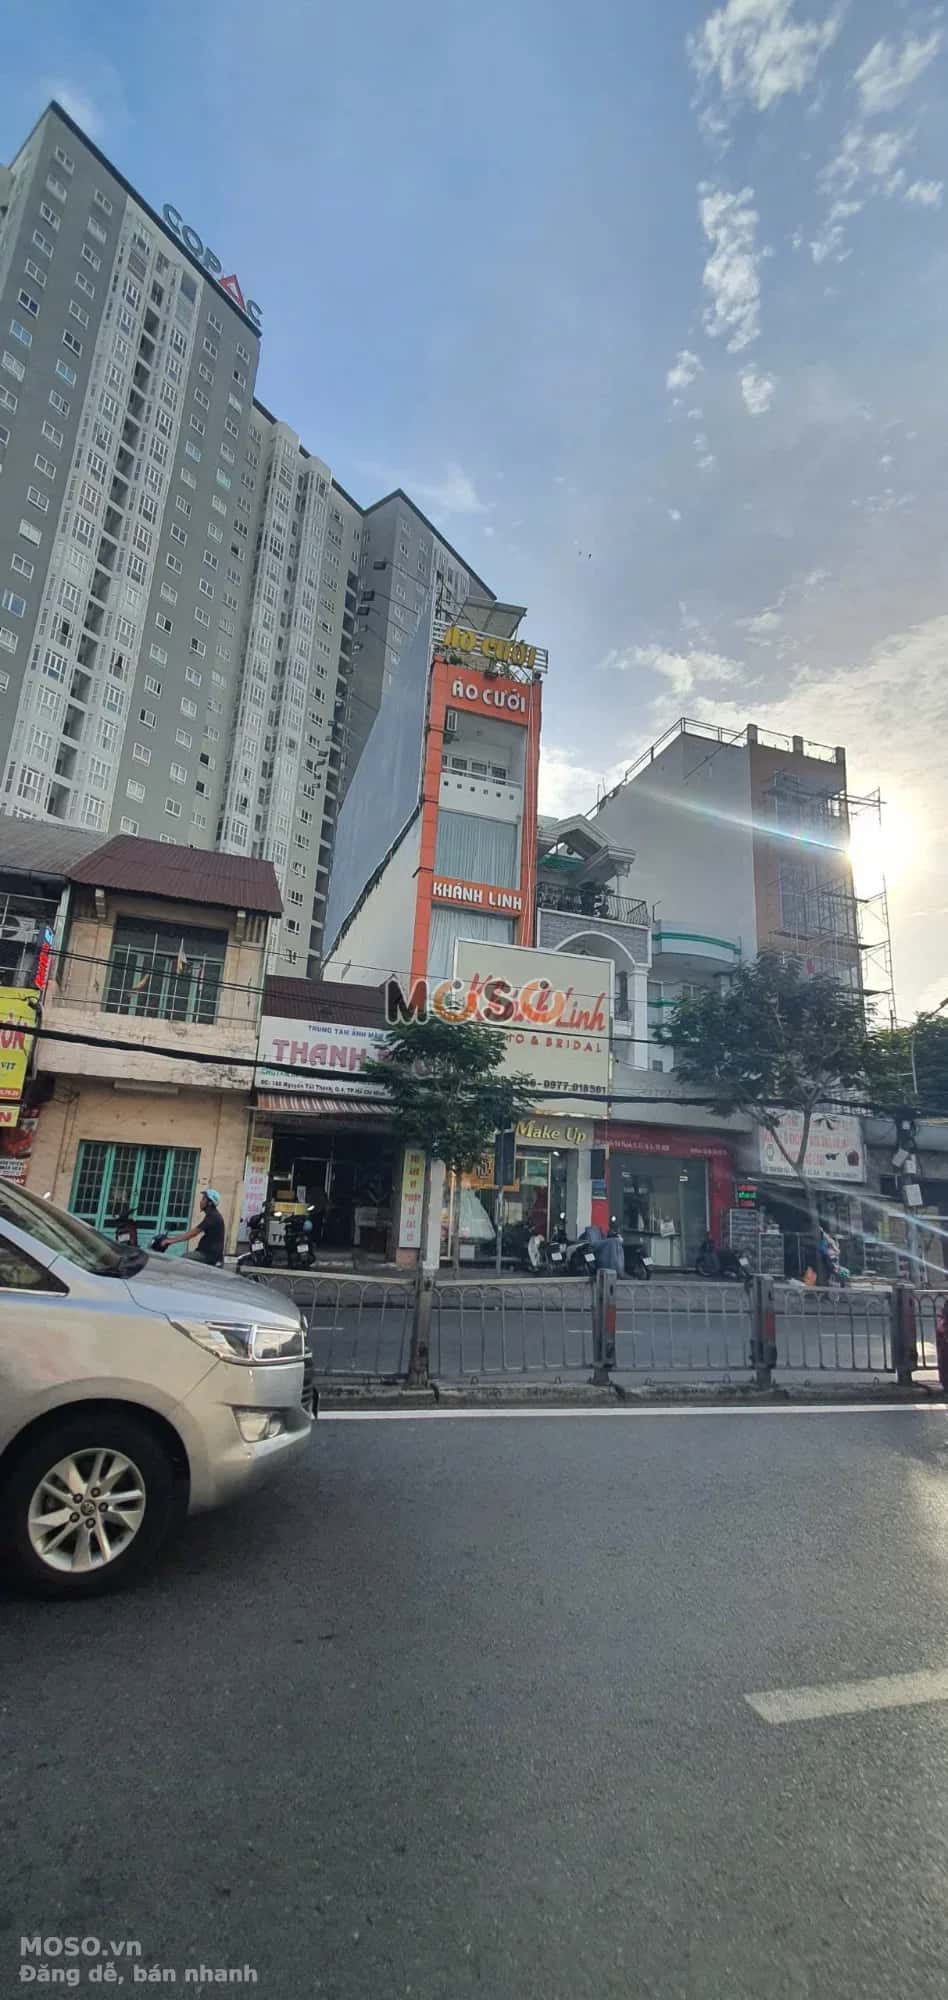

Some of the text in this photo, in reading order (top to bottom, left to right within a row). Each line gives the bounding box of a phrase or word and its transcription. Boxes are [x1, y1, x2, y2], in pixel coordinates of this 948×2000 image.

[162, 203, 264, 327] COPAC
[433, 881, 522, 910] KHÁNH LINH
[545, 1038, 603, 1053] BRIDAL
[515, 1120, 561, 1140] Make
[565, 1127, 587, 1146] Up
